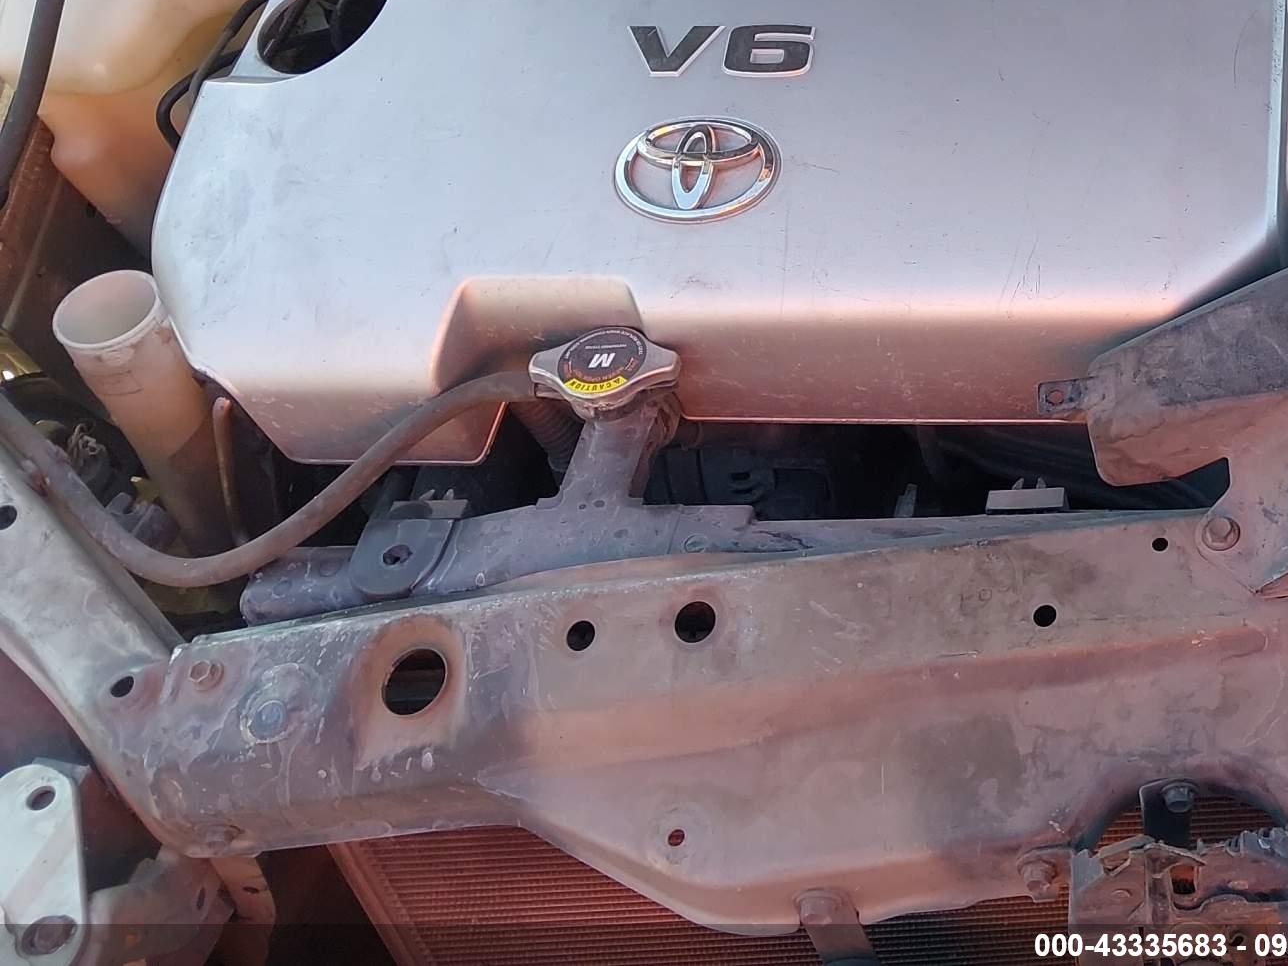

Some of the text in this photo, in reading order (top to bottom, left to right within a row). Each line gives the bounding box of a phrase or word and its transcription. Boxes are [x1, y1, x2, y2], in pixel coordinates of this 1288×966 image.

[626, 23, 817, 78] V6
[588, 352, 616, 368] M
[568, 380, 612, 392] CAUTION
